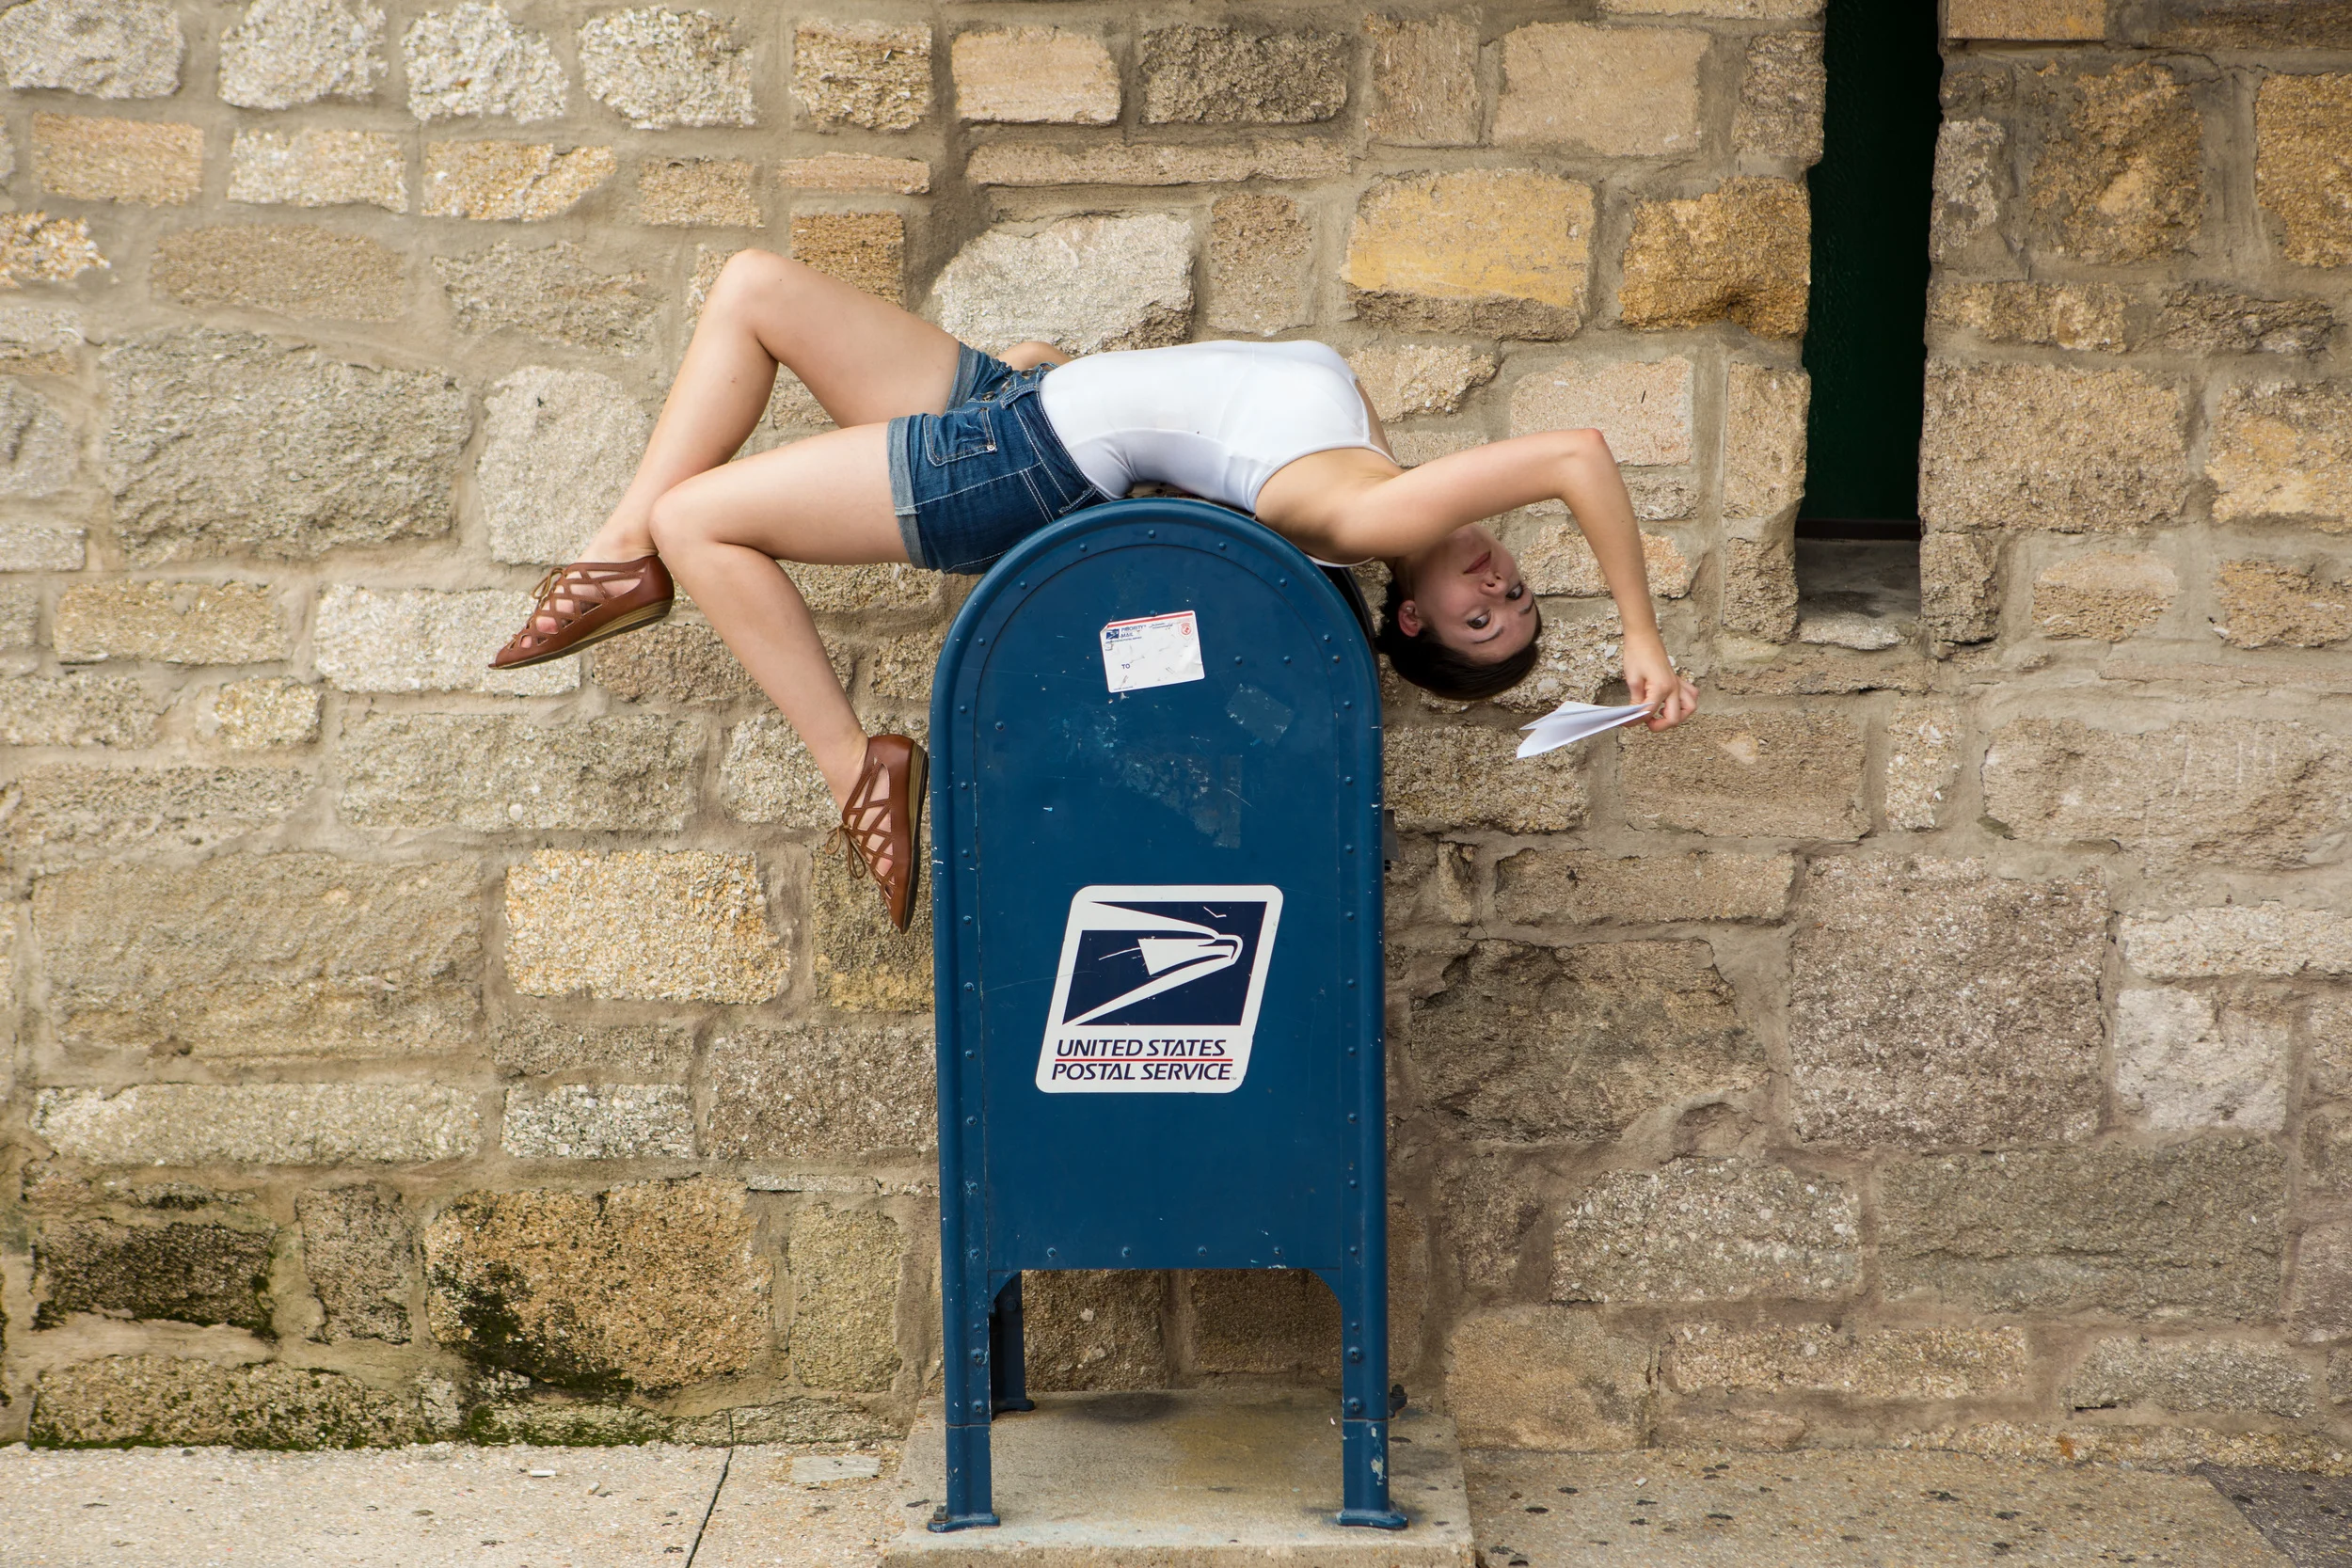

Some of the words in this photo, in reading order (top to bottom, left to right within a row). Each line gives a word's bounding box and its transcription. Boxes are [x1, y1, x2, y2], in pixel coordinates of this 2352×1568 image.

[1057, 1040, 1143, 1056] UNITED
[1147, 1039, 1226, 1056] STATES
[1052, 1064, 1135, 1080] POSTAL
[1141, 1064, 1231, 1080] SERVICE
